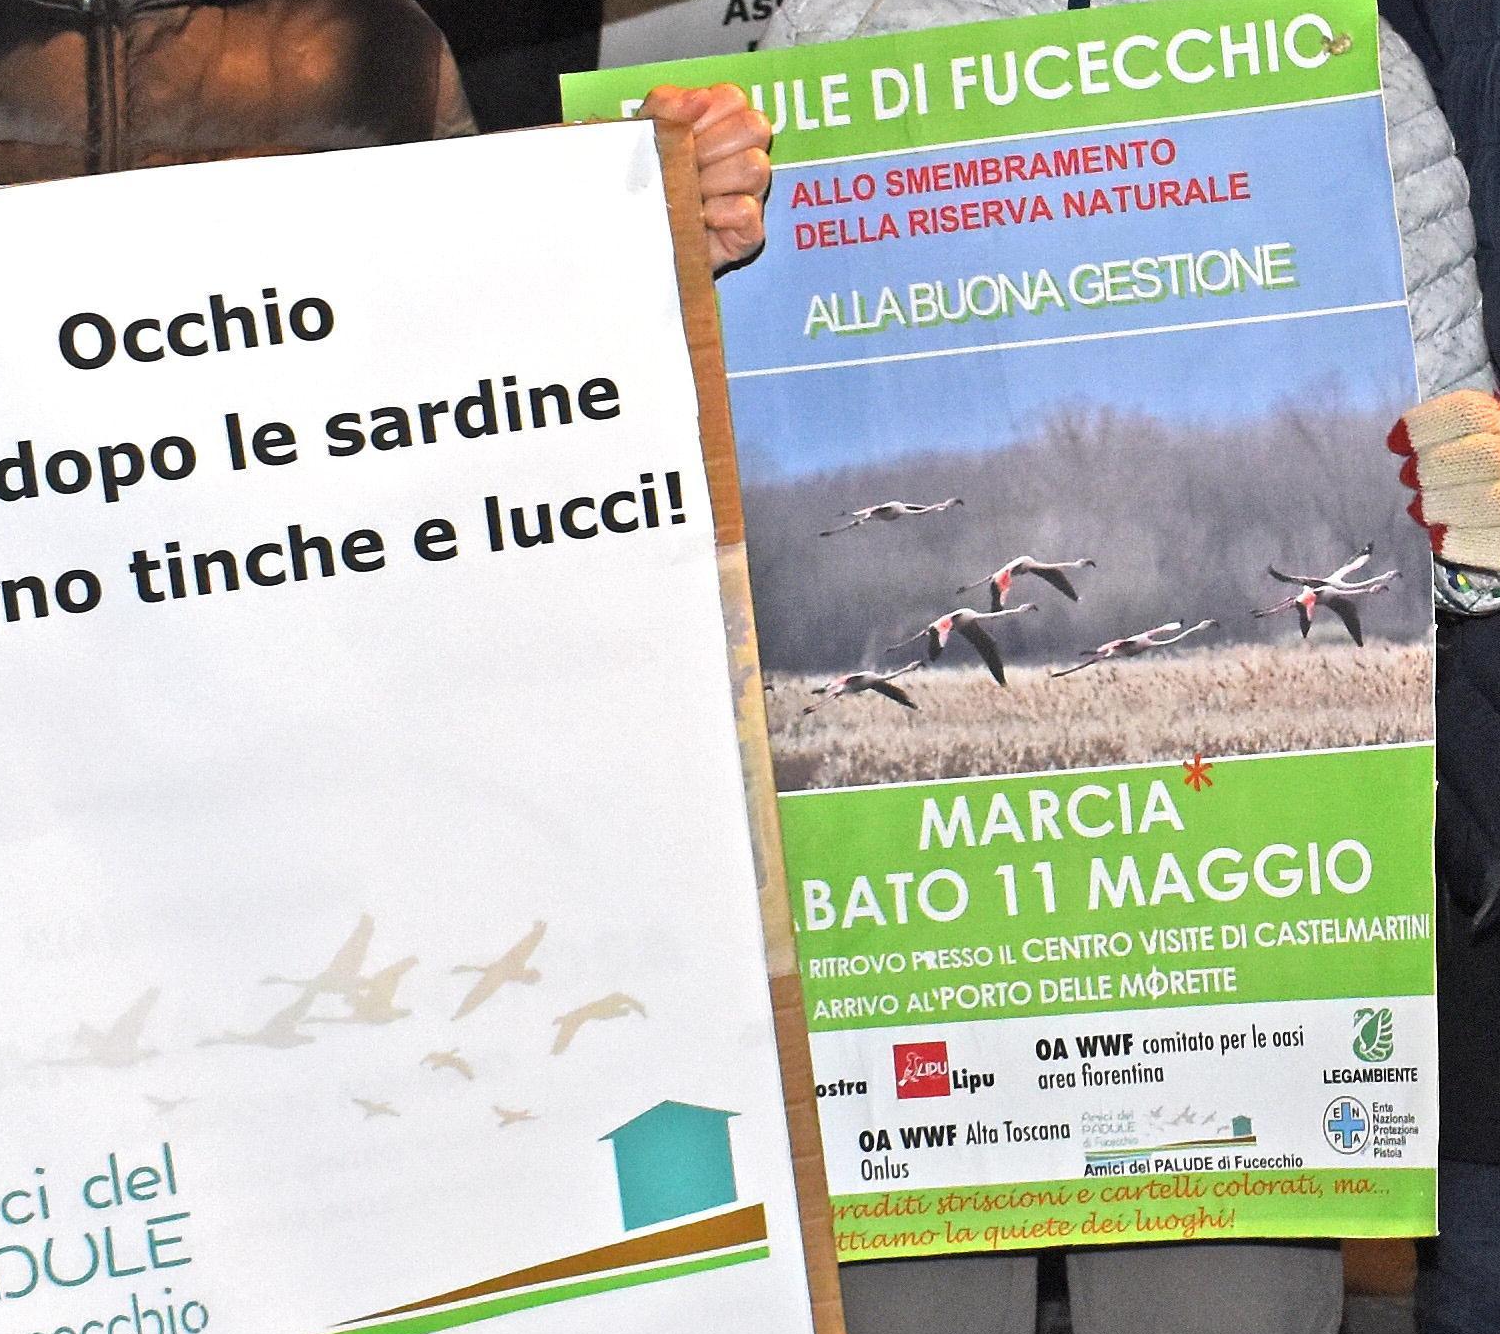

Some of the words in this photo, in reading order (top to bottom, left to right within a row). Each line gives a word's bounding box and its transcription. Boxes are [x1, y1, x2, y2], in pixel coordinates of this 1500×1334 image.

[871, 58, 929, 119] DI
[952, 13, 1334, 110] FUCECCHIO
[790, 172, 876, 210] ALLO
[885, 138, 1178, 199] SMEMBRAMENTO
[794, 207, 899, 251] DELLA
[907, 191, 1053, 240] RISERVA
[1063, 170, 1252, 221] NATURALE
[803, 286, 906, 340] ALLA
[910, 267, 1065, 327] BUONA
[1067, 242, 1300, 307] GESTIONE
[57, 288, 336, 373] Occhio
[226, 407, 300, 472] le
[324, 368, 622, 457] sardine
[129, 519, 387, 608] tinche
[413, 515, 460, 564] e
[485, 468, 689, 556] lucci!
[918, 778, 1185, 851] MARCIA
[791, 867, 969, 933] BATO
[994, 862, 1060, 917] 11
[1087, 838, 1374, 911] MAGGIO
[809, 953, 907, 979] RITROVO
[911, 946, 994, 972] PRESSO
[998, 944, 1017, 966] IL
[1021, 930, 1134, 964] CENTRO
[1139, 925, 1215, 956] VISITE
[1221, 923, 1249, 951] DI
[1253, 913, 1431, 948] CASTELMARTINI
[813, 993, 900, 1022] ARRIVO
[1038, 973, 1113, 1005] DELLE
[1035, 1037, 1070, 1062] OA
[1075, 1033, 1134, 1059] WWF
[1142, 1030, 1215, 1055] comitato
[1220, 1031, 1247, 1056] per
[1251, 1023, 1267, 1049] le
[1272, 1025, 1305, 1049] oasi
[917, 1060, 949, 1078] LIPU
[952, 1068, 996, 1095] Lipu
[1038, 1069, 1077, 1090] area
[1082, 1062, 1165, 1089] fiorentina
[1323, 1067, 1419, 1085] LEGAMBIENTE
[858, 1129, 893, 1153] OA
[900, 1123, 958, 1150] WWF
[966, 1120, 999, 1146] Alta
[1003, 1120, 1071, 1145] Toscana
[1372, 1113, 1416, 1124] Nazionale
[1373, 1136, 1407, 1146] Animali
[82, 1143, 180, 1210] del
[860, 1155, 911, 1182] Onlus
[1084, 1162, 1126, 1178] Amici
[1129, 1159, 1151, 1175] del
[1155, 1156, 1214, 1173] PALUDE
[1217, 1156, 1231, 1170] di
[1234, 1153, 1304, 1169] Fucecchio
[936, 1183, 1074, 1215] striscioni
[1077, 1189, 1096, 1205] e
[1101, 1175, 1209, 1203] cartelli
[1213, 1172, 1324, 1200] colorati,
[945, 1220, 979, 1244] la
[983, 1217, 1075, 1250] quiete
[1080, 1211, 1132, 1235] dei
[1135, 1207, 1237, 1239] luoghi!
